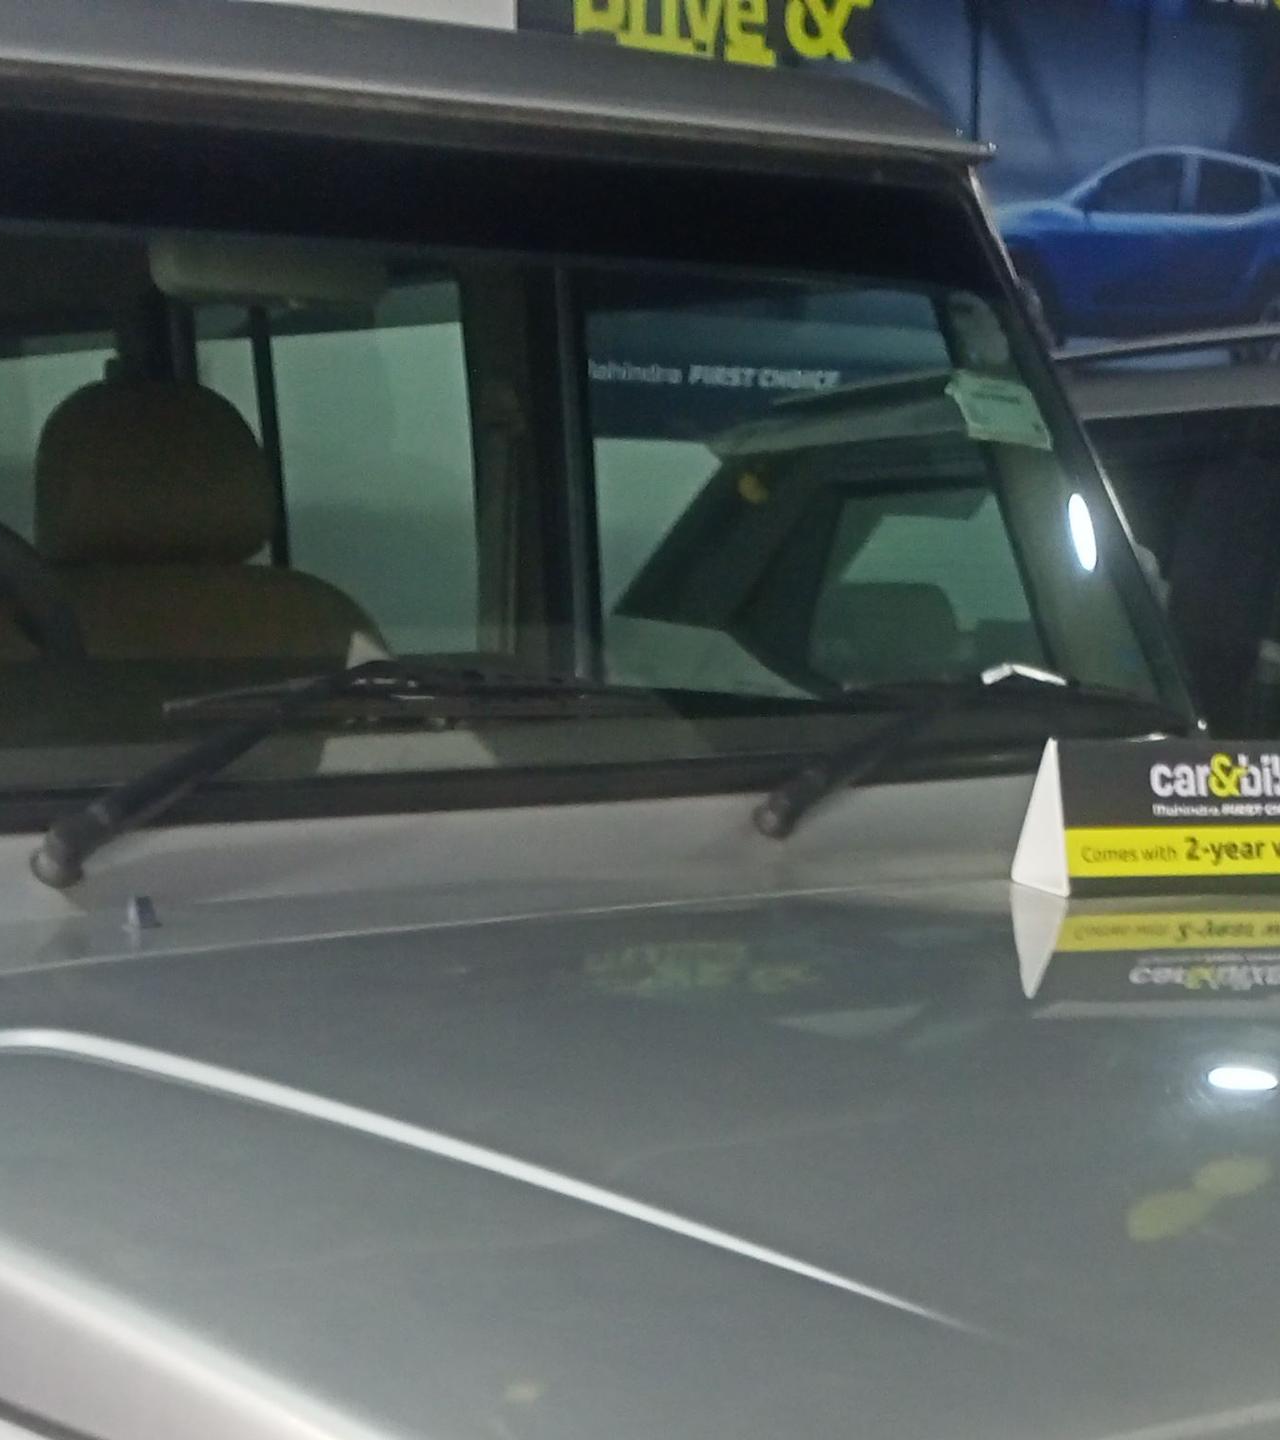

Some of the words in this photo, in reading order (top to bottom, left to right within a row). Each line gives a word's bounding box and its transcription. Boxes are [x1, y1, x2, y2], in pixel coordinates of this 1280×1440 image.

[1081, 844, 1138, 864] Comes
[1141, 844, 1177, 862] with
[1185, 836, 1265, 866] 2-year
